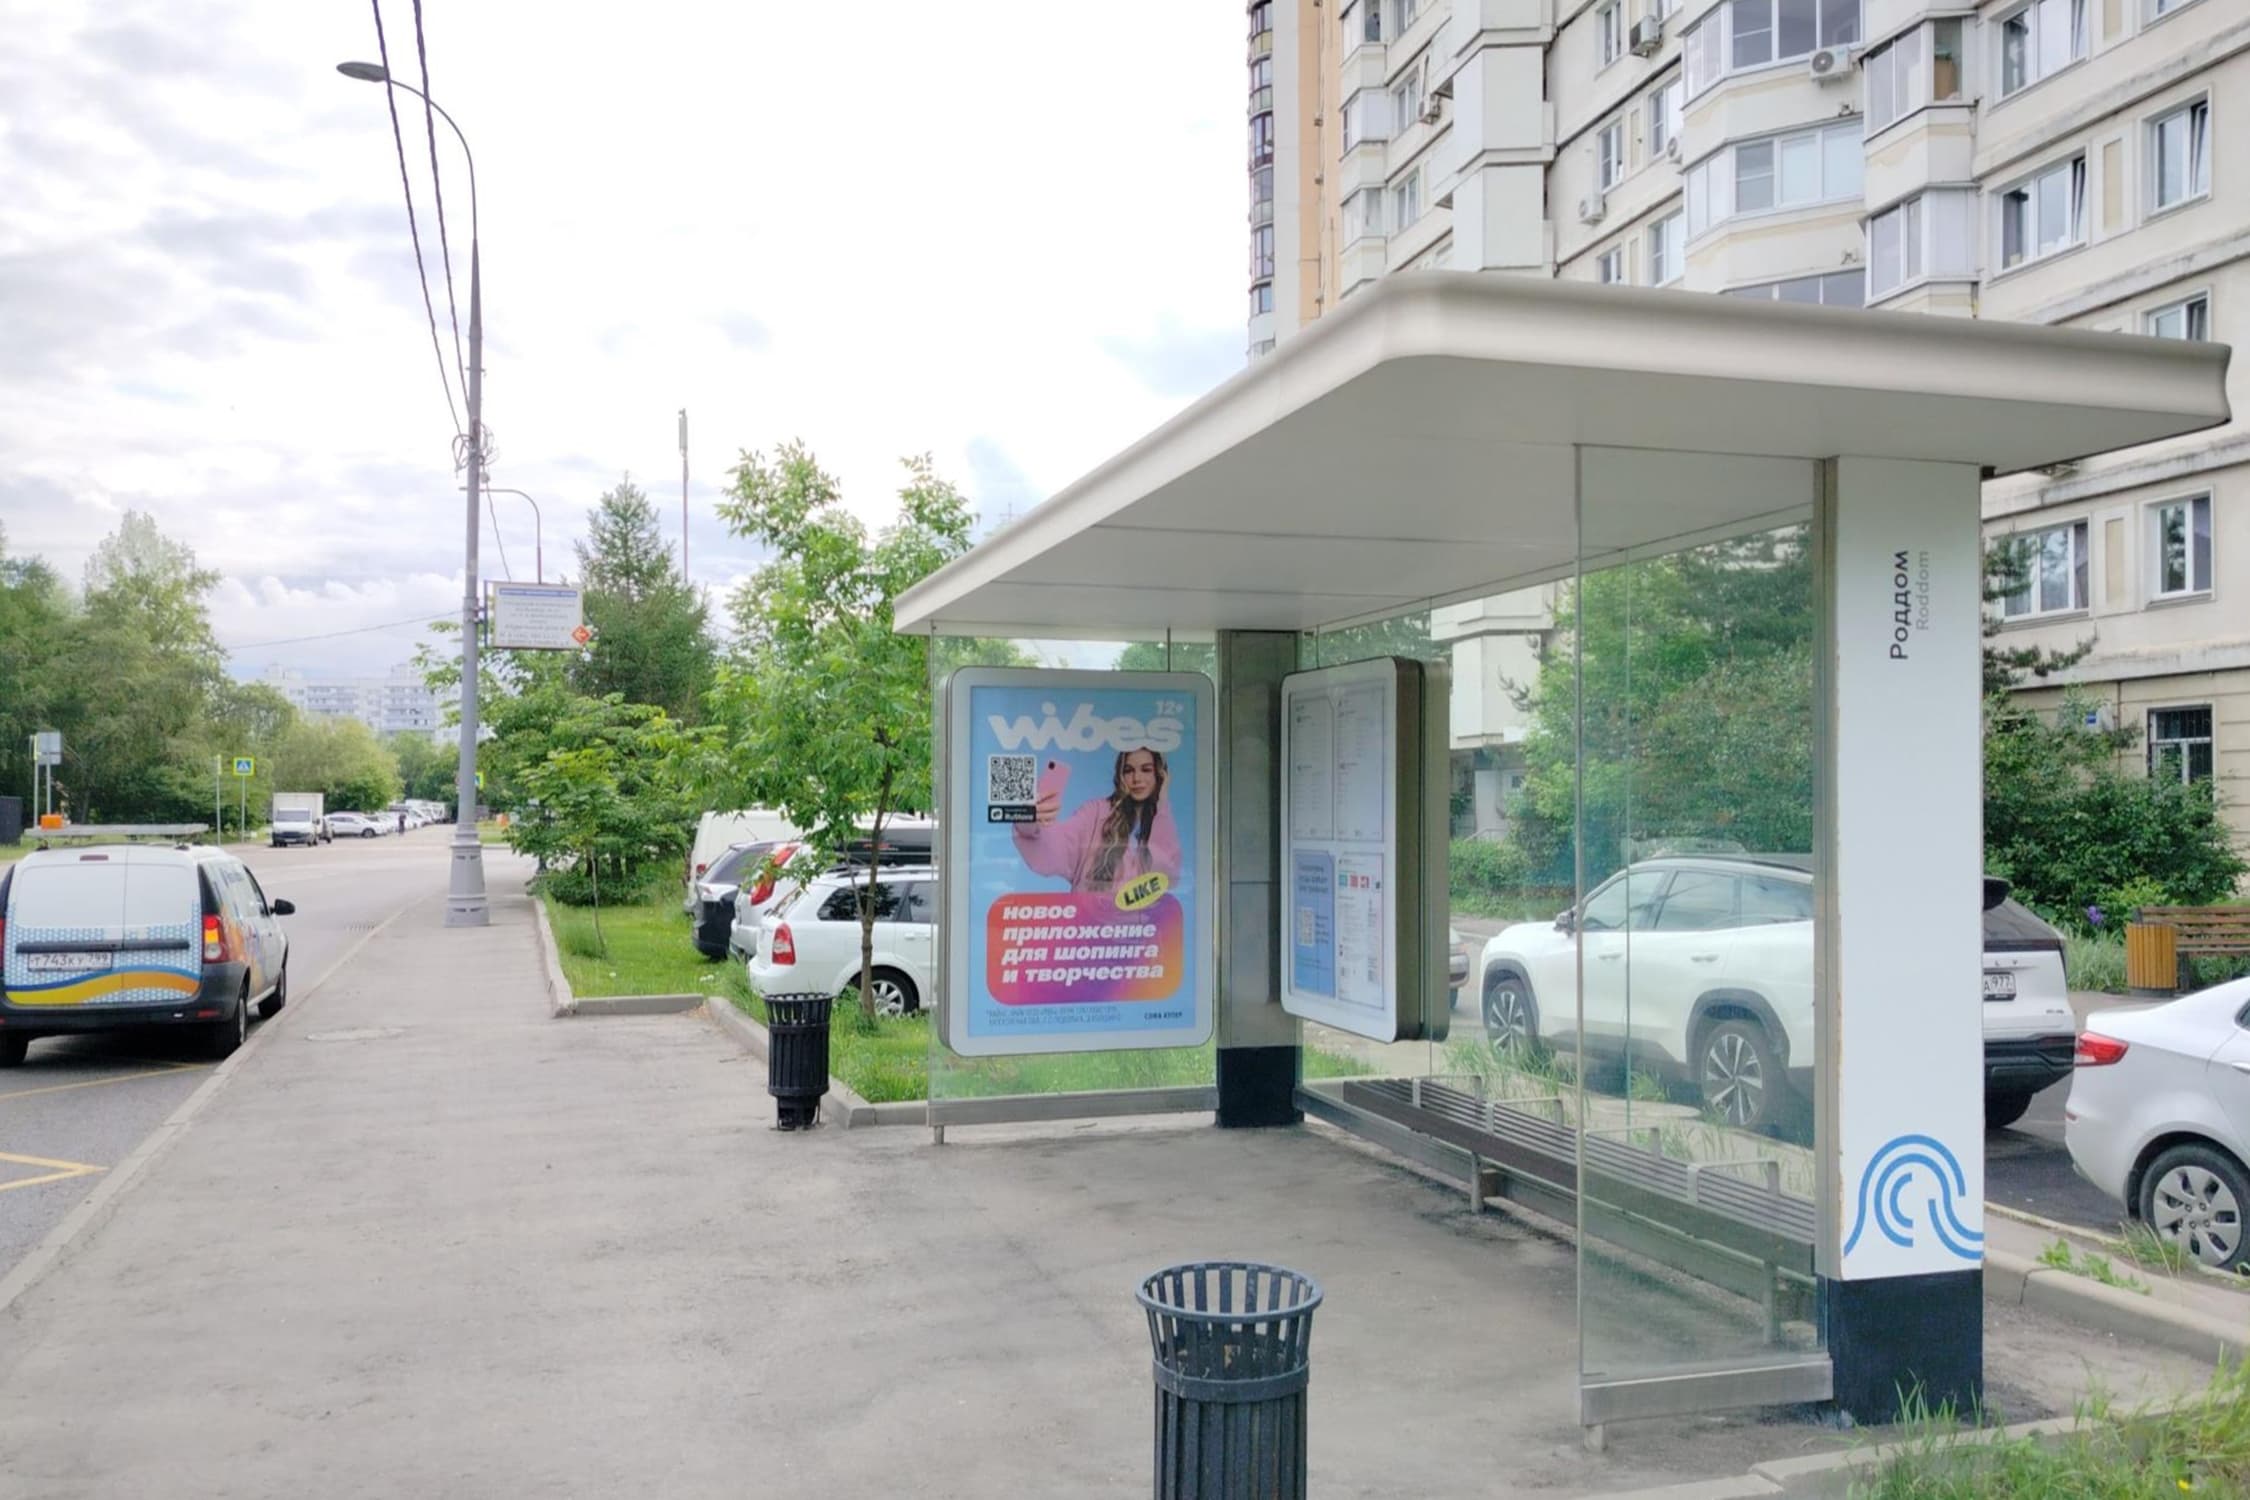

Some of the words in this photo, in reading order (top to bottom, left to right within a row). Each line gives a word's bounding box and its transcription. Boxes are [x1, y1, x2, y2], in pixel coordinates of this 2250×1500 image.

[1916, 551, 1929, 630] Roddom
[1890, 550, 1911, 660] Роддом
[1123, 876, 1162, 906] LIKE
[1003, 905, 1077, 920] новое
[1003, 923, 1157, 946] приложение
[1001, 947, 1049, 966] для
[1053, 944, 1159, 962] шопинга
[1002, 969, 1018, 984] и
[1025, 965, 1164, 987] творчества
